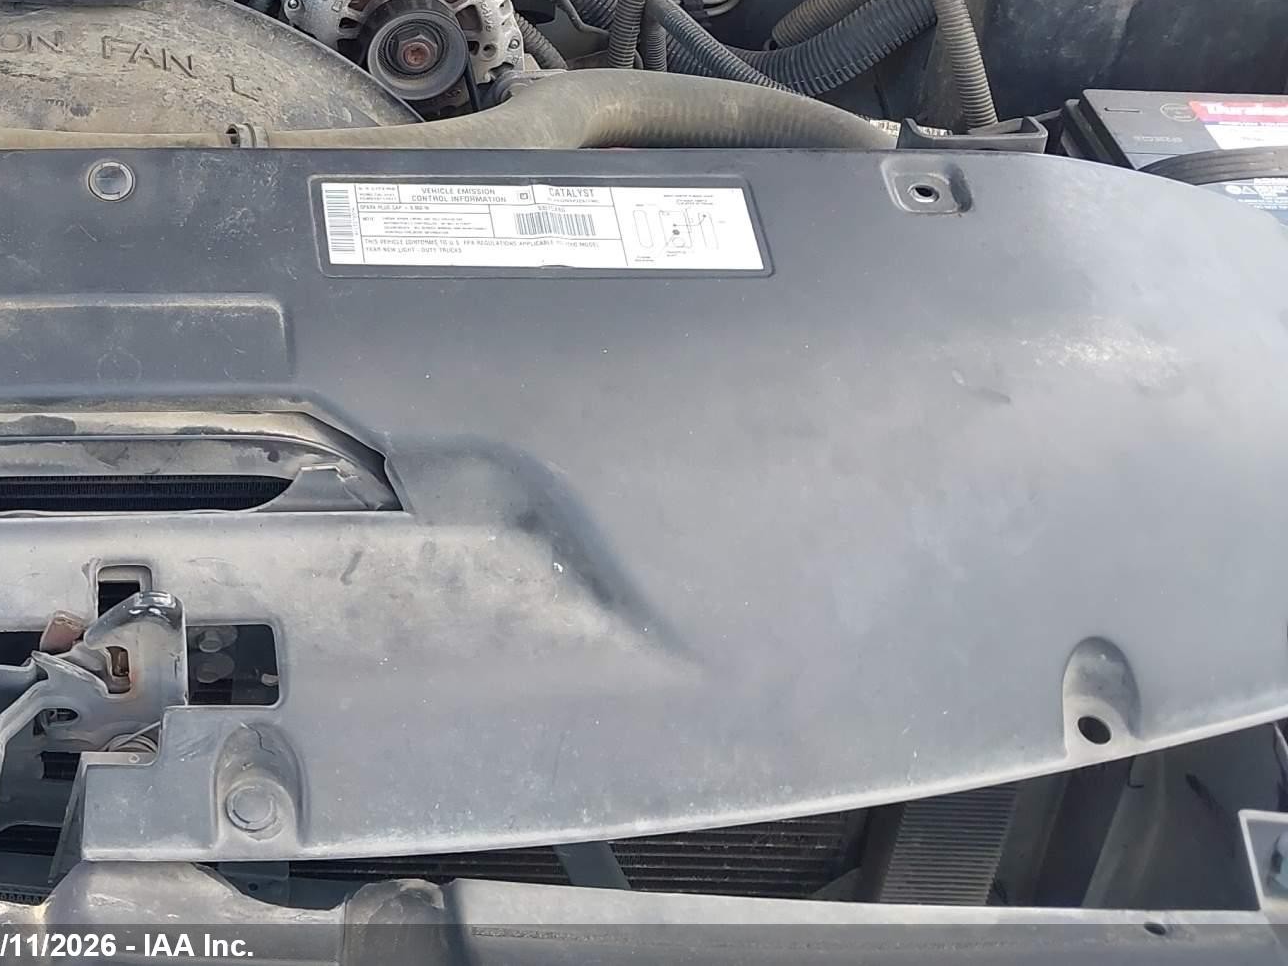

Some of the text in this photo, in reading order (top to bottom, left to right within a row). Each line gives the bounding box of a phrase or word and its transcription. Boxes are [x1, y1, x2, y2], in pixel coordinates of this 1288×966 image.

[100, 34, 198, 79] FAN
[421, 187, 496, 196] VEHICLE EMISSION
[548, 187, 595, 198] CATALYST
[411, 195, 507, 203] CONTROL INFORMATION
